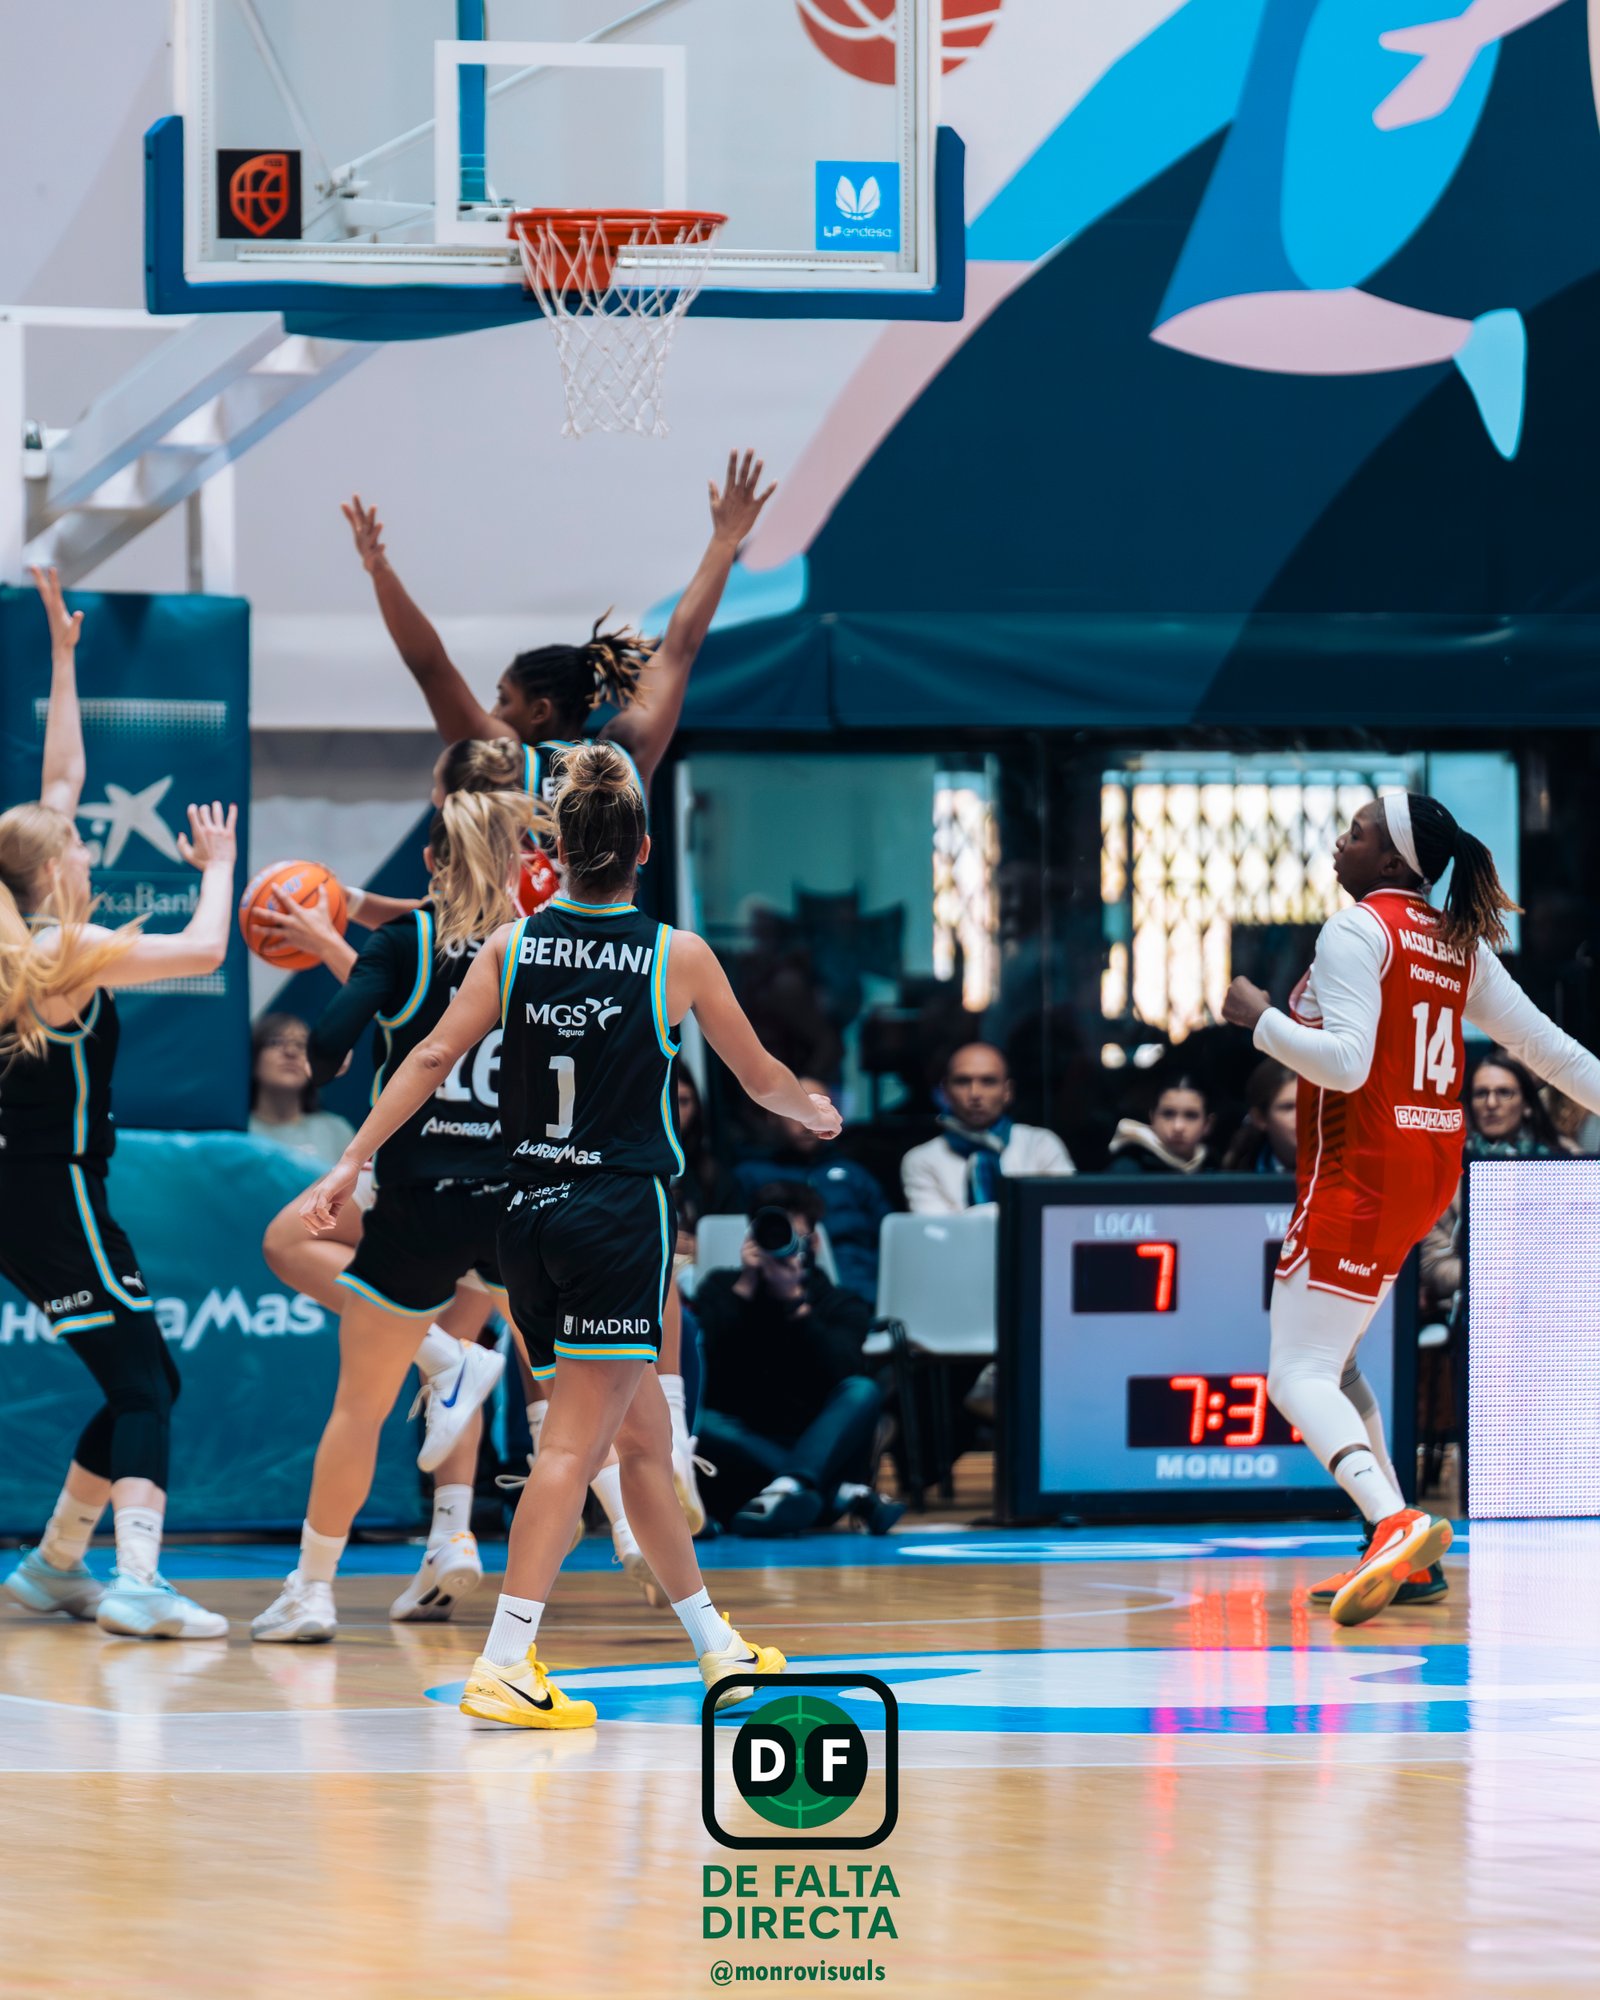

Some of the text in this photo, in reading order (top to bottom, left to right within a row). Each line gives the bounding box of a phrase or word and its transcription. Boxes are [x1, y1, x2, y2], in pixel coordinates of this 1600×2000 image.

[518, 936, 653, 975] BERKANI
[525, 1003, 587, 1027] MGS
[558, 1027, 585, 1038] Seguros
[1412, 1001, 1457, 1096] 14
[545, 1055, 576, 1139] 1
[1396, 1107, 1461, 1131] BAUHAUS
[1094, 1212, 1156, 1236] LOCAL
[1136, 1243, 1175, 1312] 7
[581, 1318, 650, 1335] MADRID
[1170, 1376, 1304, 1447] 7:3
[1156, 1454, 1279, 1480] MONDO
